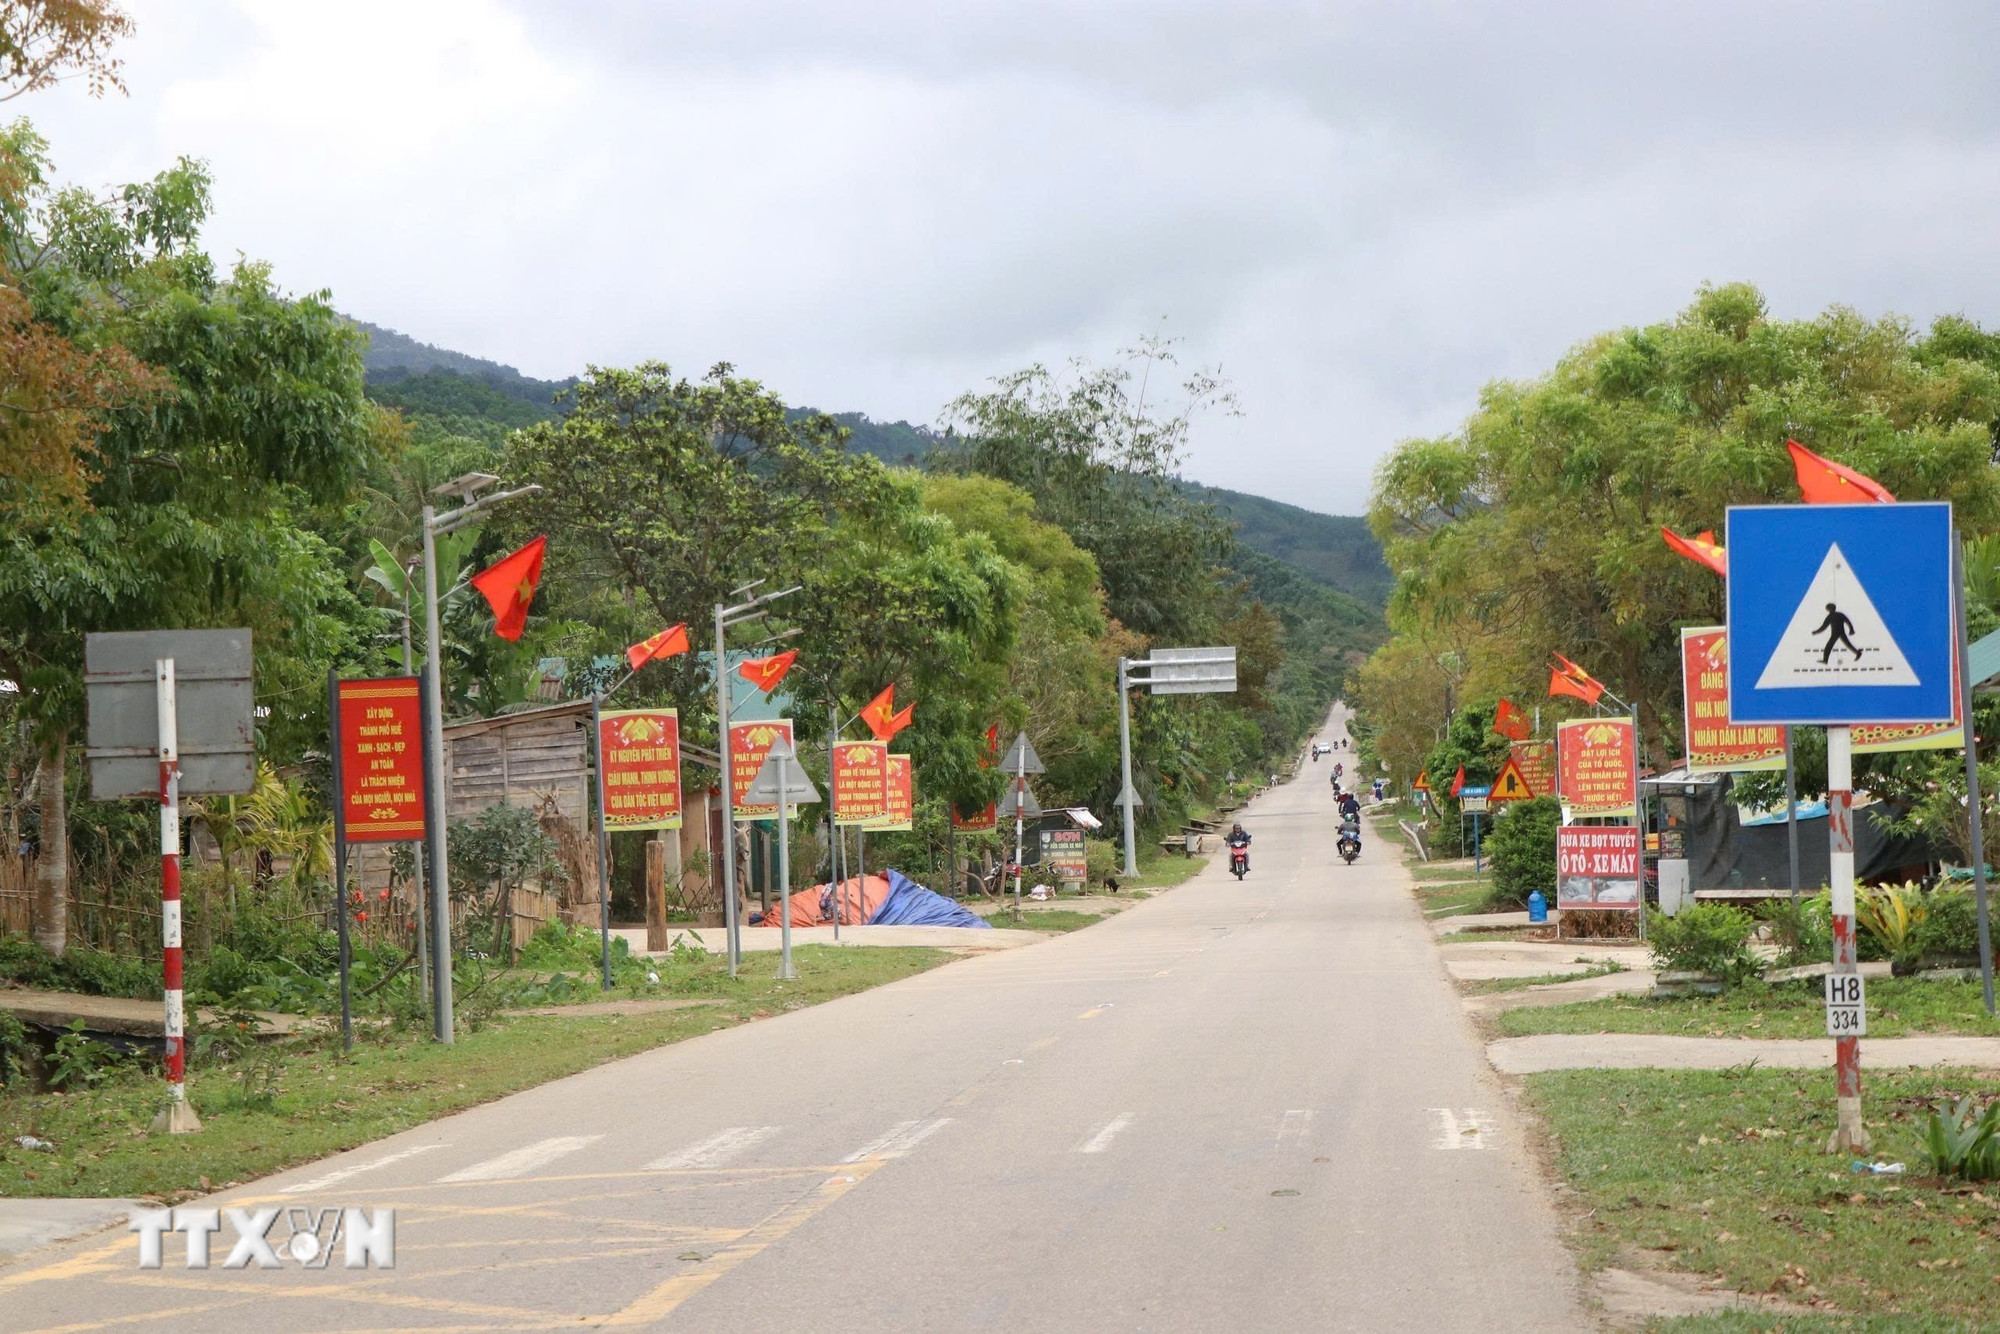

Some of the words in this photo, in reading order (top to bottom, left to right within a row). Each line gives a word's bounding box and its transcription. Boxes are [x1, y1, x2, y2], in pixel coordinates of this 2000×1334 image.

[1701, 667, 1723, 689] ĐẢNG
[366, 706, 378, 719] XÂY
[378, 705, 394, 721] DỰNG
[1695, 698, 1712, 718] NHÀ
[360, 723, 378, 736] THÀNH
[379, 721, 390, 736] PHỐ
[391, 720, 402, 735] HUẾ
[1695, 726, 1717, 746] NHÂN
[1720, 726, 1736, 745] DÂN
[1739, 725, 1756, 744] LÀM
[358, 743, 373, 753] XANH
[376, 742, 391, 755] SẠCH
[394, 741, 406, 755] ĐẸP
[618, 746, 640, 762] NGUYÊN
[641, 746, 655, 761] PHÁT
[1596, 750, 1607, 758] LỢI
[1609, 748, 1620, 756] ÍCH
[371, 759, 379, 770] AN
[379, 756, 394, 769] TOÀN
[734, 752, 749, 762] PHÁT
[751, 752, 762, 761] HUY
[1578, 759, 1592, 768] CỦA
[1594, 757, 1602, 767] TỔ
[746, 765, 756, 777] HỘI
[1576, 771, 1590, 780] CỦA
[1592, 770, 1611, 779] NHÂN
[1613, 770, 1627, 778] DÂN
[361, 774, 369, 788] LÀ
[369, 774, 387, 787] TRÁCH
[388, 773, 406, 789] NHIỆM
[735, 779, 742, 790] VÀ
[1579, 783, 1591, 791] LÊN
[1593, 782, 1610, 790] TRÊN
[351, 790, 363, 805] CỦA
[611, 791, 623, 808] CỦA
[623, 792, 635, 808] DÂN
[636, 792, 647, 810] TỘC
[647, 791, 659, 809] VIỆT
[1561, 831, 1577, 847] RỬA
[1579, 834, 1590, 847] XE
[1592, 835, 1607, 849] BỌT
[1610, 830, 1636, 847] TUYẾT
[1561, 849, 1569, 873] Ô
[1571, 849, 1586, 873] TÔ
[1593, 854, 1609, 873] XE
[1611, 849, 1636, 873] MÁY
[1832, 977, 1860, 1002] H8
[1833, 1011, 1858, 1029] 334
